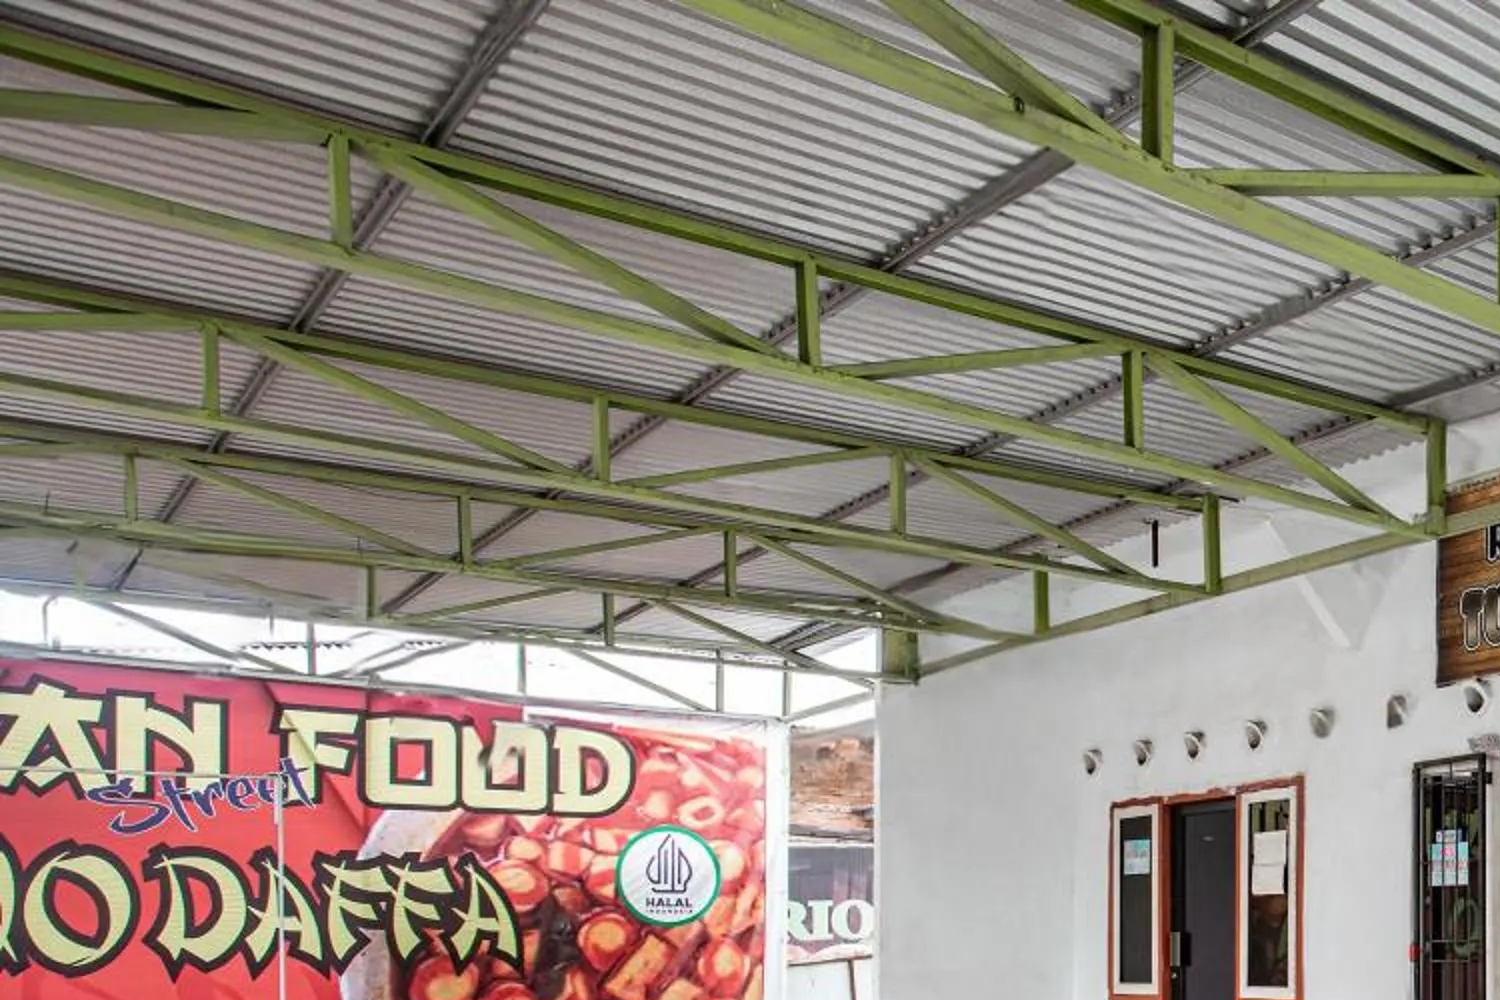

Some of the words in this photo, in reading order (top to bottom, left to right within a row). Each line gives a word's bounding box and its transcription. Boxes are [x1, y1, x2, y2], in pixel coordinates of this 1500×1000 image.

[84, 756, 317, 835] Street
[269, 704, 636, 817] FOOD
[645, 897, 692, 908] HALAL
